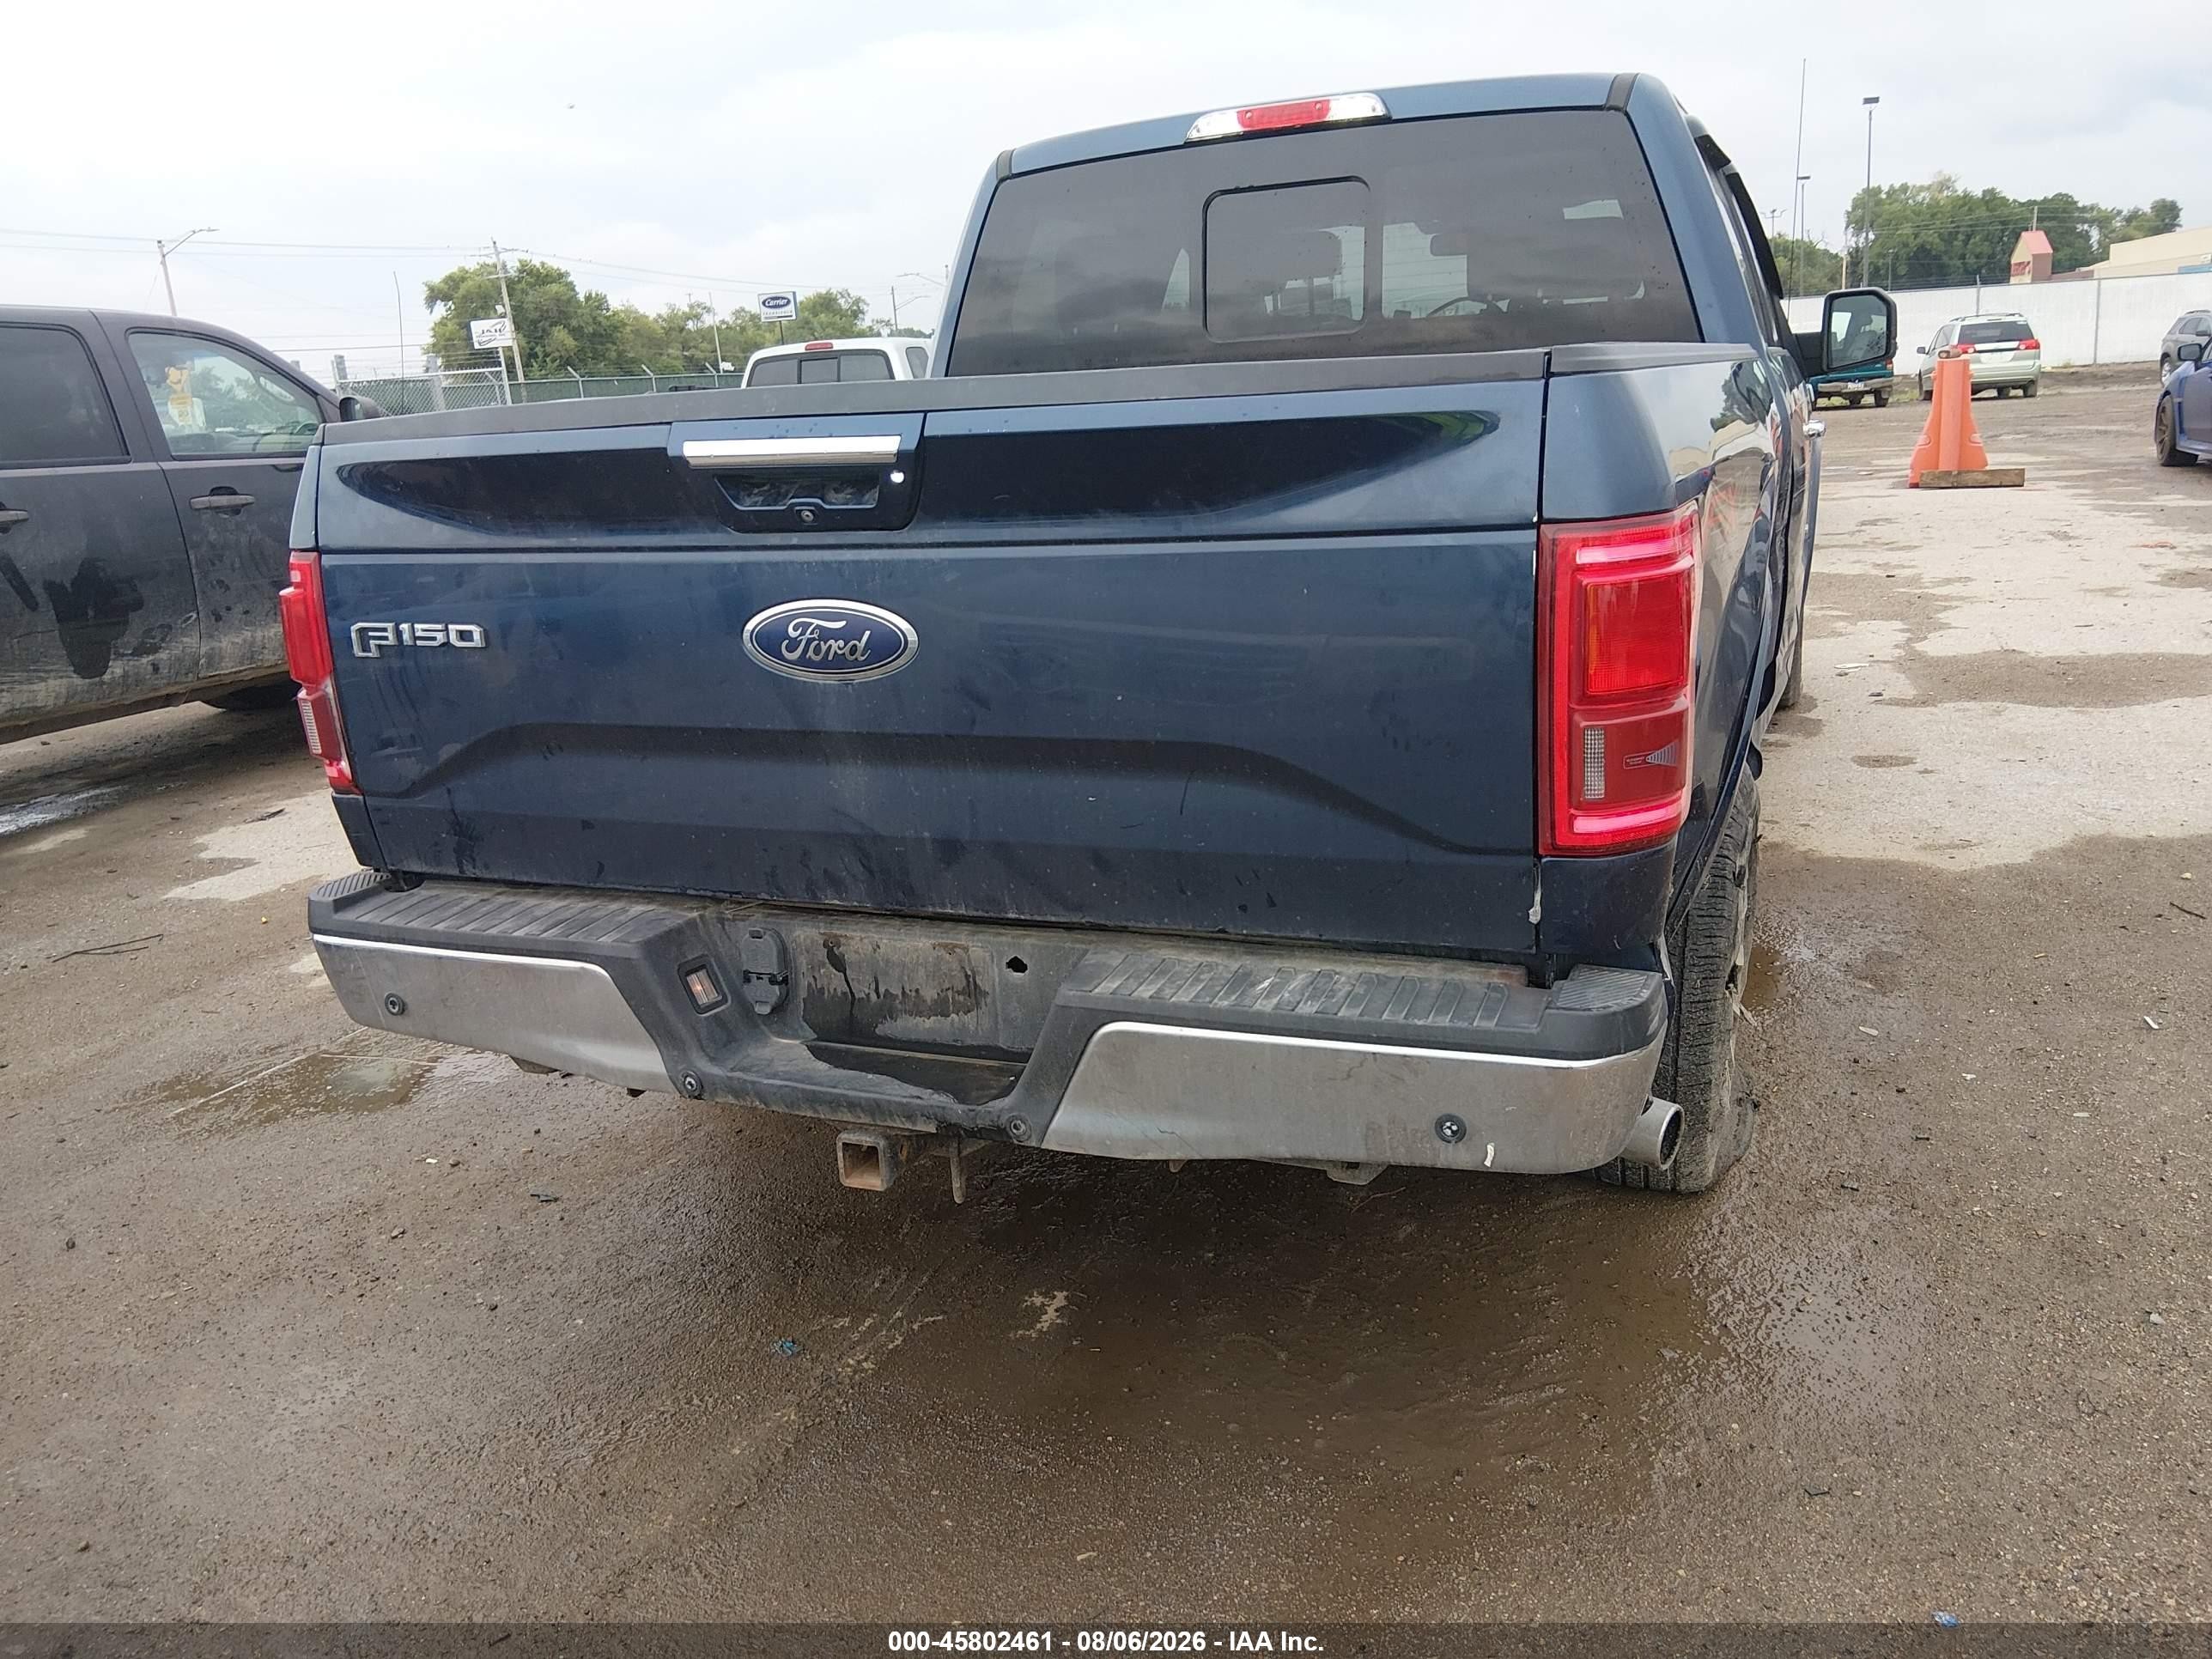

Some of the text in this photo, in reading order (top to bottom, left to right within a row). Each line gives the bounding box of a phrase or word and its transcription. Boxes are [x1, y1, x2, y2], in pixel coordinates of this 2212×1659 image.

[764, 298, 789, 307] Carrier
[350, 622, 486, 658] F150
[781, 617, 872, 660] Ford
